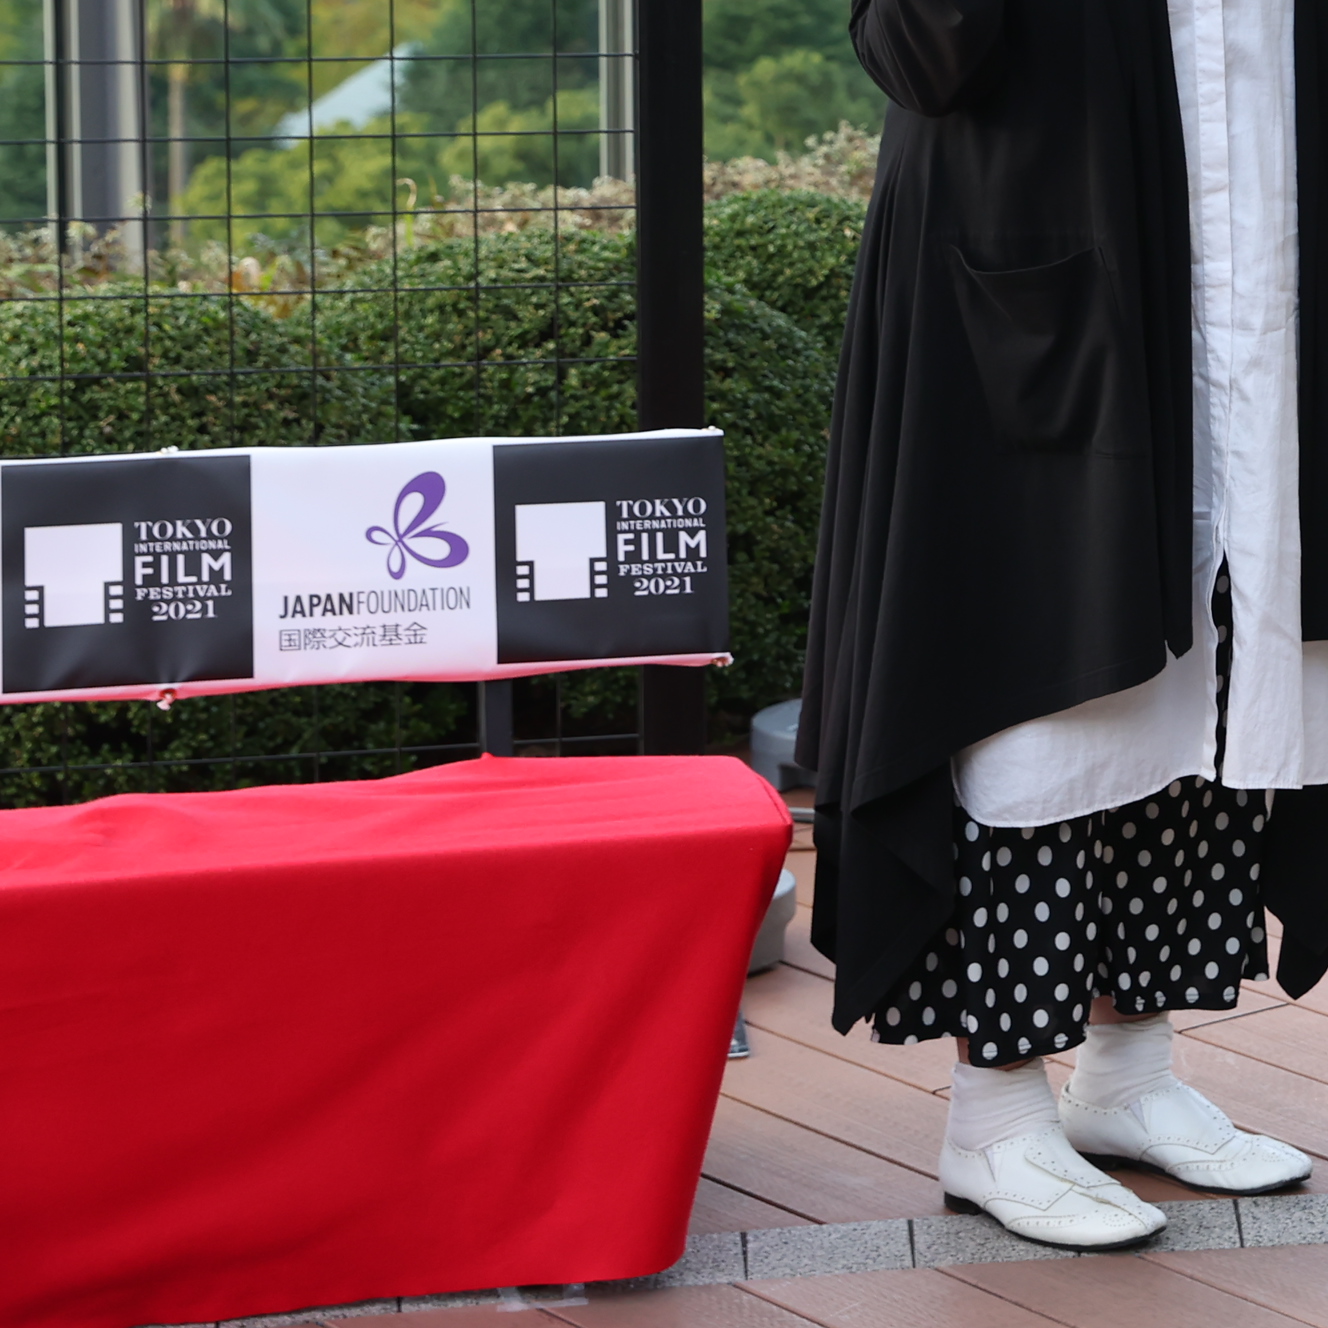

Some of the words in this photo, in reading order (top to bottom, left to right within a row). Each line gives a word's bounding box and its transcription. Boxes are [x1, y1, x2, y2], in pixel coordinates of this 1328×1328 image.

[616, 496, 707, 518] TOKYO
[133, 517, 233, 541] TOKYO
[616, 517, 706, 531] INTERNATIONAL
[134, 539, 231, 554] INTERNATIONAL
[616, 529, 707, 562] FILM
[134, 551, 232, 586] FILM
[618, 560, 708, 576] FESTIVAL
[135, 583, 233, 601] FESTIVAL
[633, 575, 694, 596] 2021
[151, 599, 218, 621] 2021
[279, 622, 428, 652] 国際交流基金
